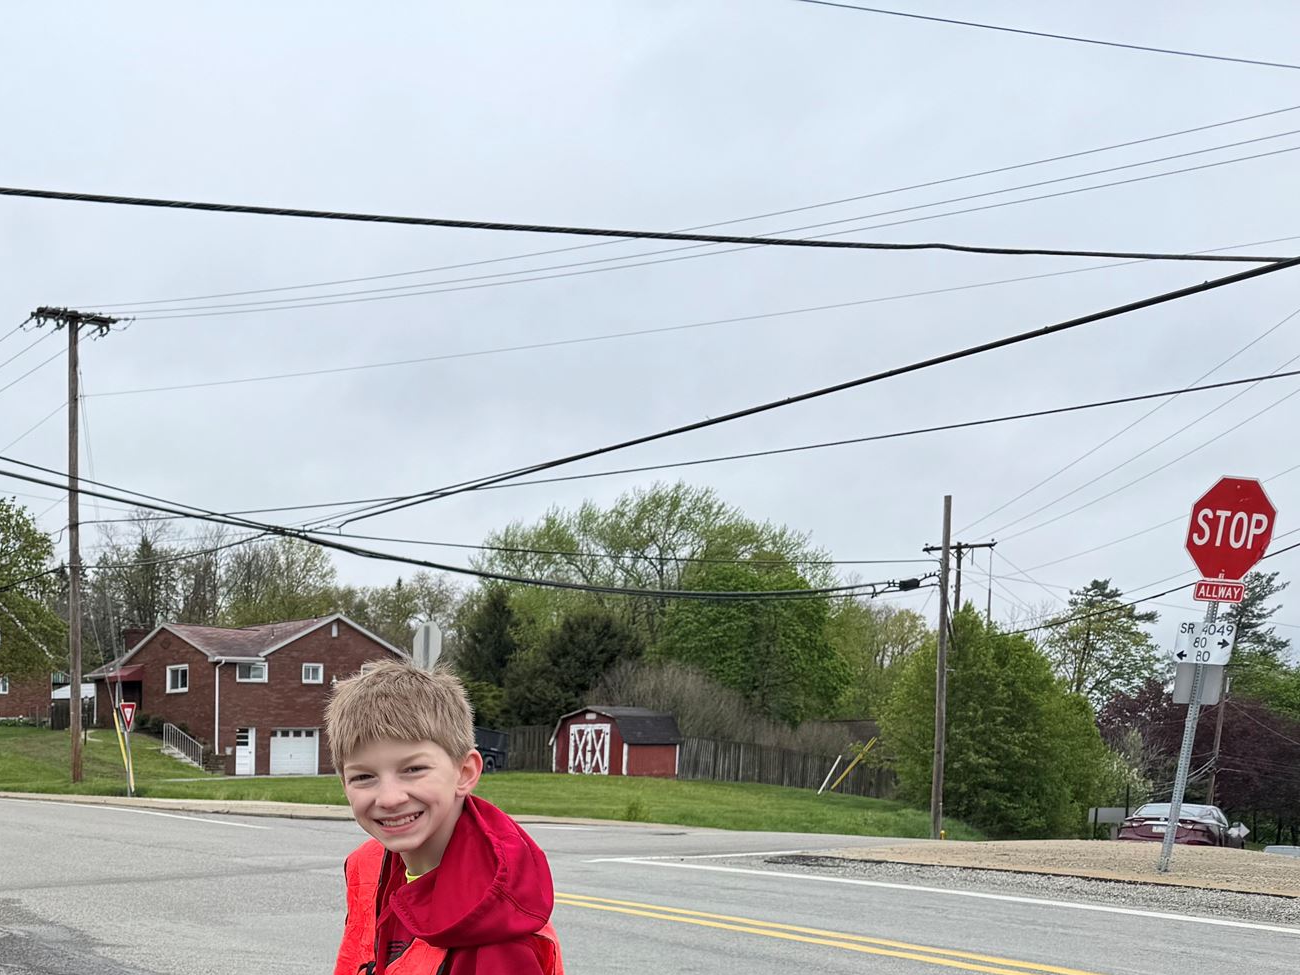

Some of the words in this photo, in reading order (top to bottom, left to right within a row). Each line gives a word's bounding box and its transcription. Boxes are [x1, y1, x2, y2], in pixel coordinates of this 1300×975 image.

[1192, 508, 1268, 550] STOP
[1180, 622, 1195, 634] SR
[1202, 623, 1234, 636] 4049
[1193, 637, 1207, 648] 80
[1196, 650, 1210, 662] 80
